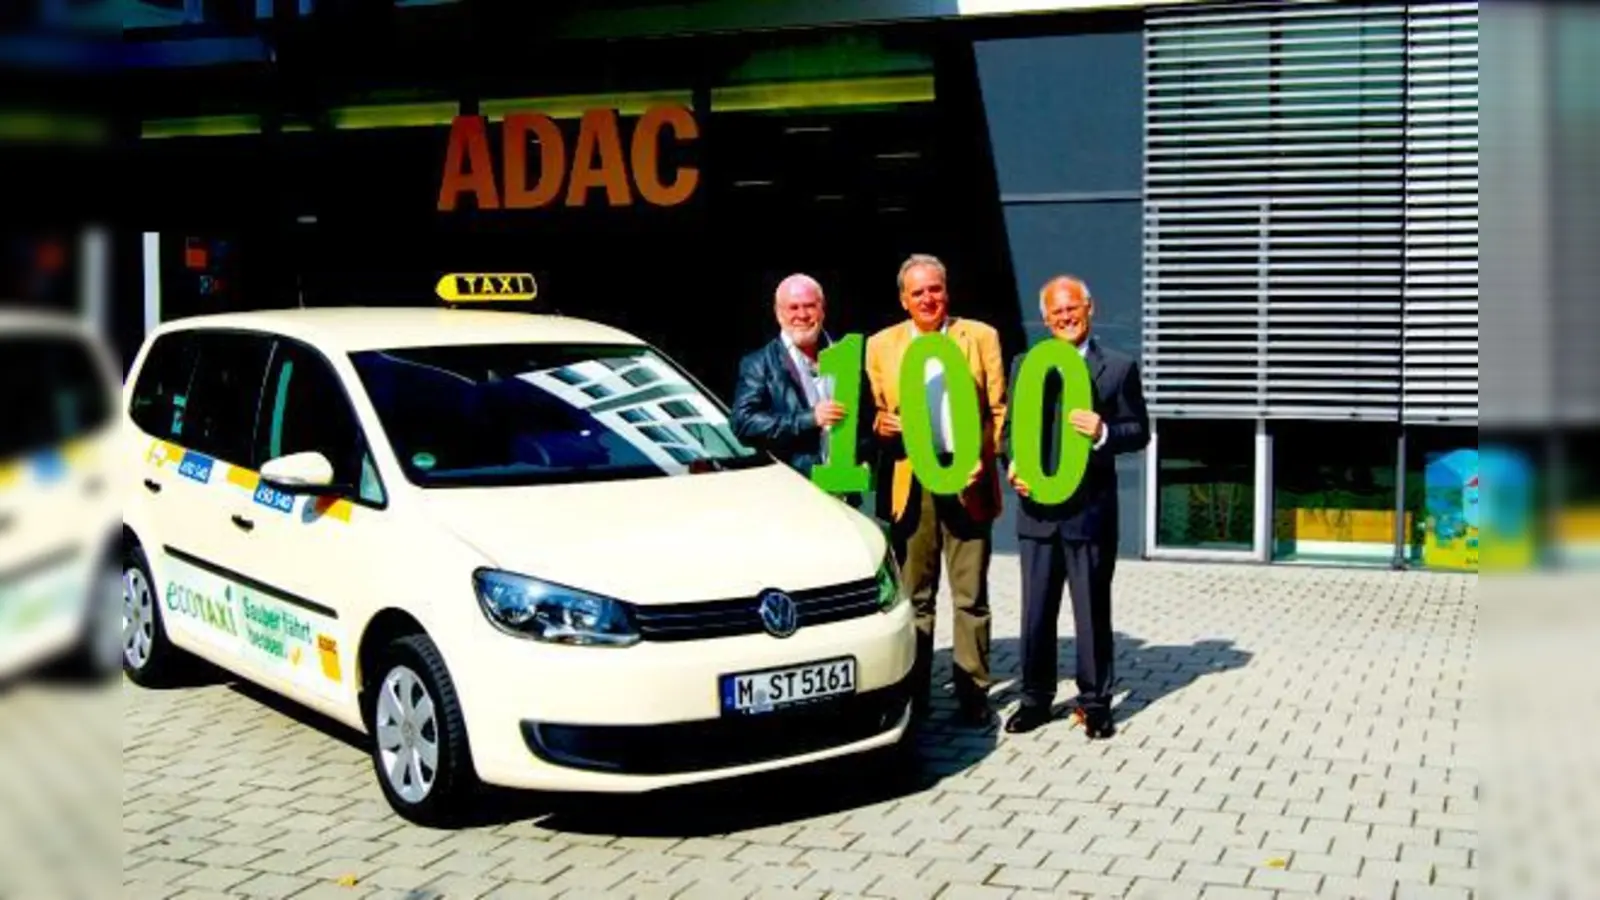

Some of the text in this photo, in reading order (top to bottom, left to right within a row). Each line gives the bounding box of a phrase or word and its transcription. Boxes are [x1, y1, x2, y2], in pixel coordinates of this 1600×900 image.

[437, 104, 699, 211] ADAC
[464, 275, 525, 295] TAXI
[737, 678, 753, 705] M
[769, 673, 797, 700] ST
[802, 663, 852, 696] 5161
